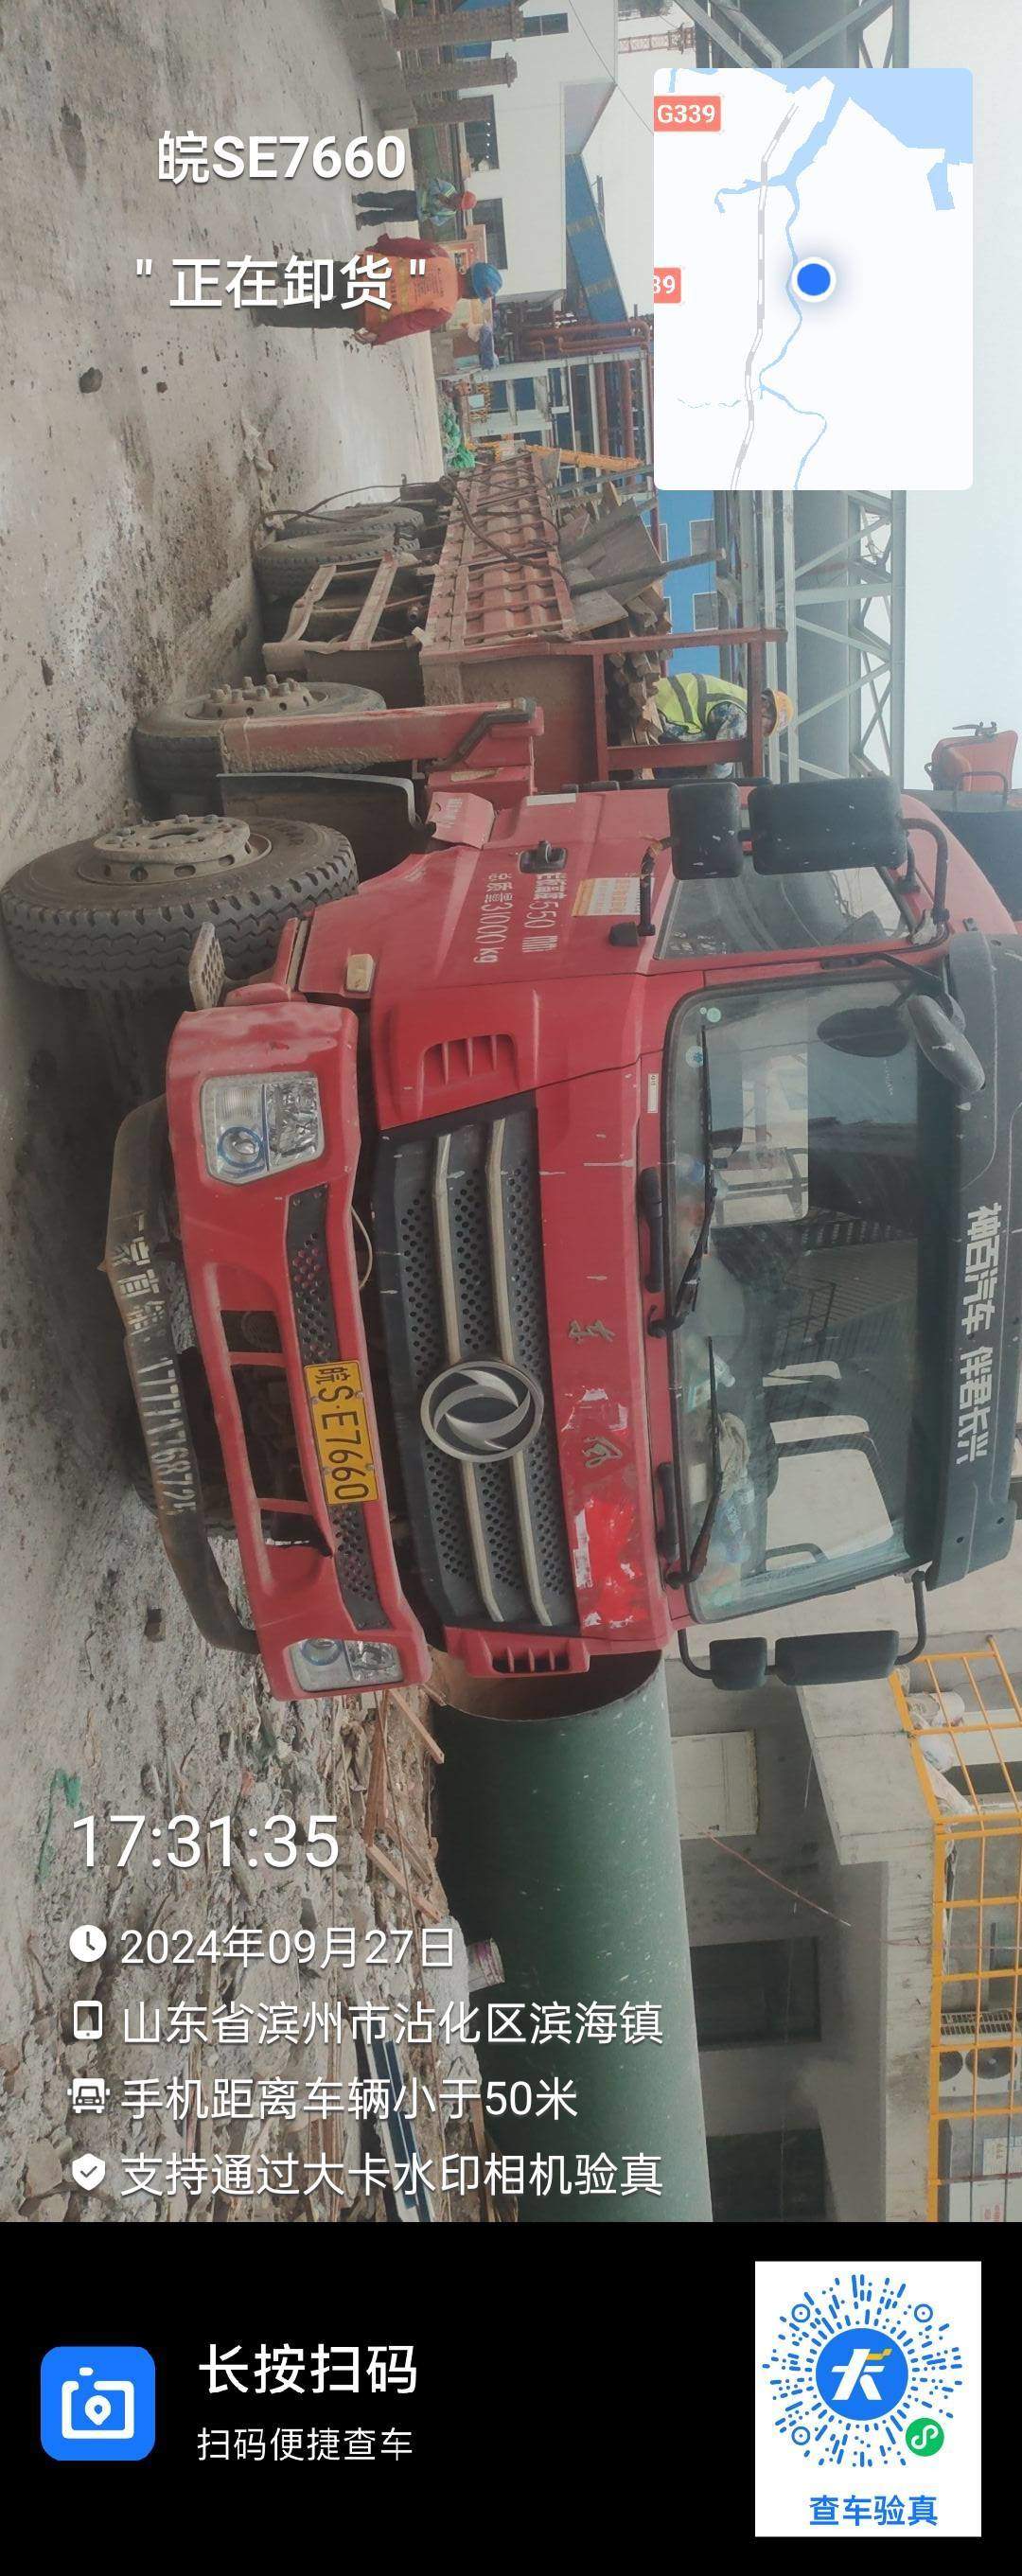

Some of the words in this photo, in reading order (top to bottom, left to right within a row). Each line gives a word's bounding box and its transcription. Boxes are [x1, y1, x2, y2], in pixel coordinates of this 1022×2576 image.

[960, 1202, 1001, 1334] 神百汽车
[954, 1346, 993, 1466] 伴君长兴
